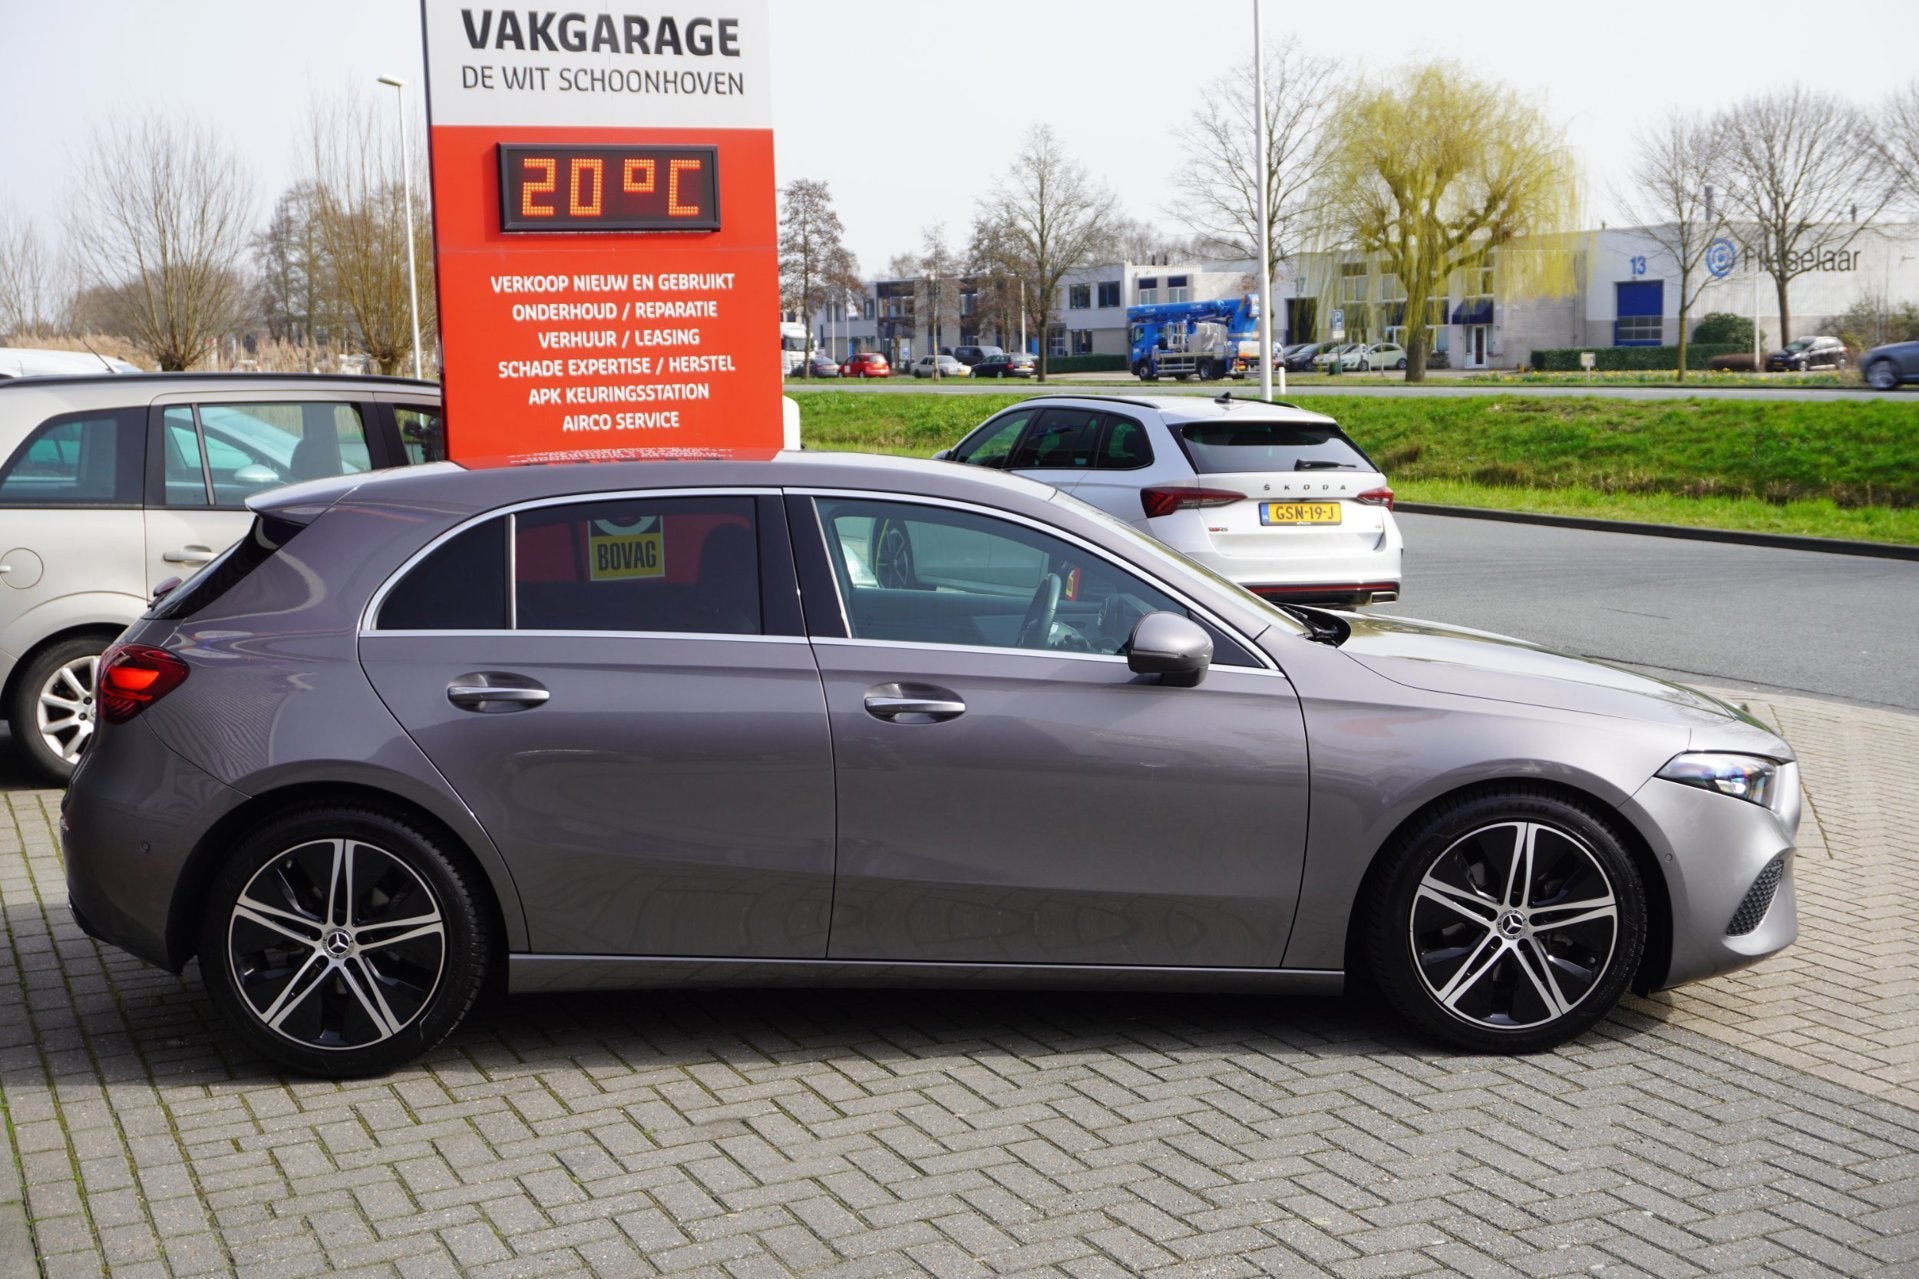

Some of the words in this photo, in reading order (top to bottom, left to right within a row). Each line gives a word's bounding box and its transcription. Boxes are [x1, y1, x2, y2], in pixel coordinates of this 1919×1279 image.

[461, 9, 741, 57] VAKGARAGE
[462, 65, 494, 90] DE
[502, 66, 550, 91] WIT
[559, 68, 744, 95] SCHOONHOVEN
[522, 158, 602, 216] 20
[1630, 255, 1646, 275] 13
[490, 275, 569, 293] VERKOOP
[573, 274, 628, 292] NIEUW
[633, 273, 654, 291] EN
[658, 272, 736, 291] GEBRUIKT
[512, 302, 618, 322] ONDERHOUD
[635, 300, 718, 319] REPARATIE
[538, 330, 618, 349] VERHUUR
[635, 328, 701, 347] LEASING
[498, 359, 564, 379] SCHADE
[568, 357, 652, 376] EXPERTISE
[669, 354, 736, 373] HERSTEL
[528, 387, 562, 406] APK
[566, 382, 710, 405] KEURINGSSTATION
[562, 413, 613, 433] AIRCO
[615, 411, 680, 431] SERVICE
[1275, 505, 1335, 521] GSN-19-J
[597, 540, 657, 571] BOVAG
